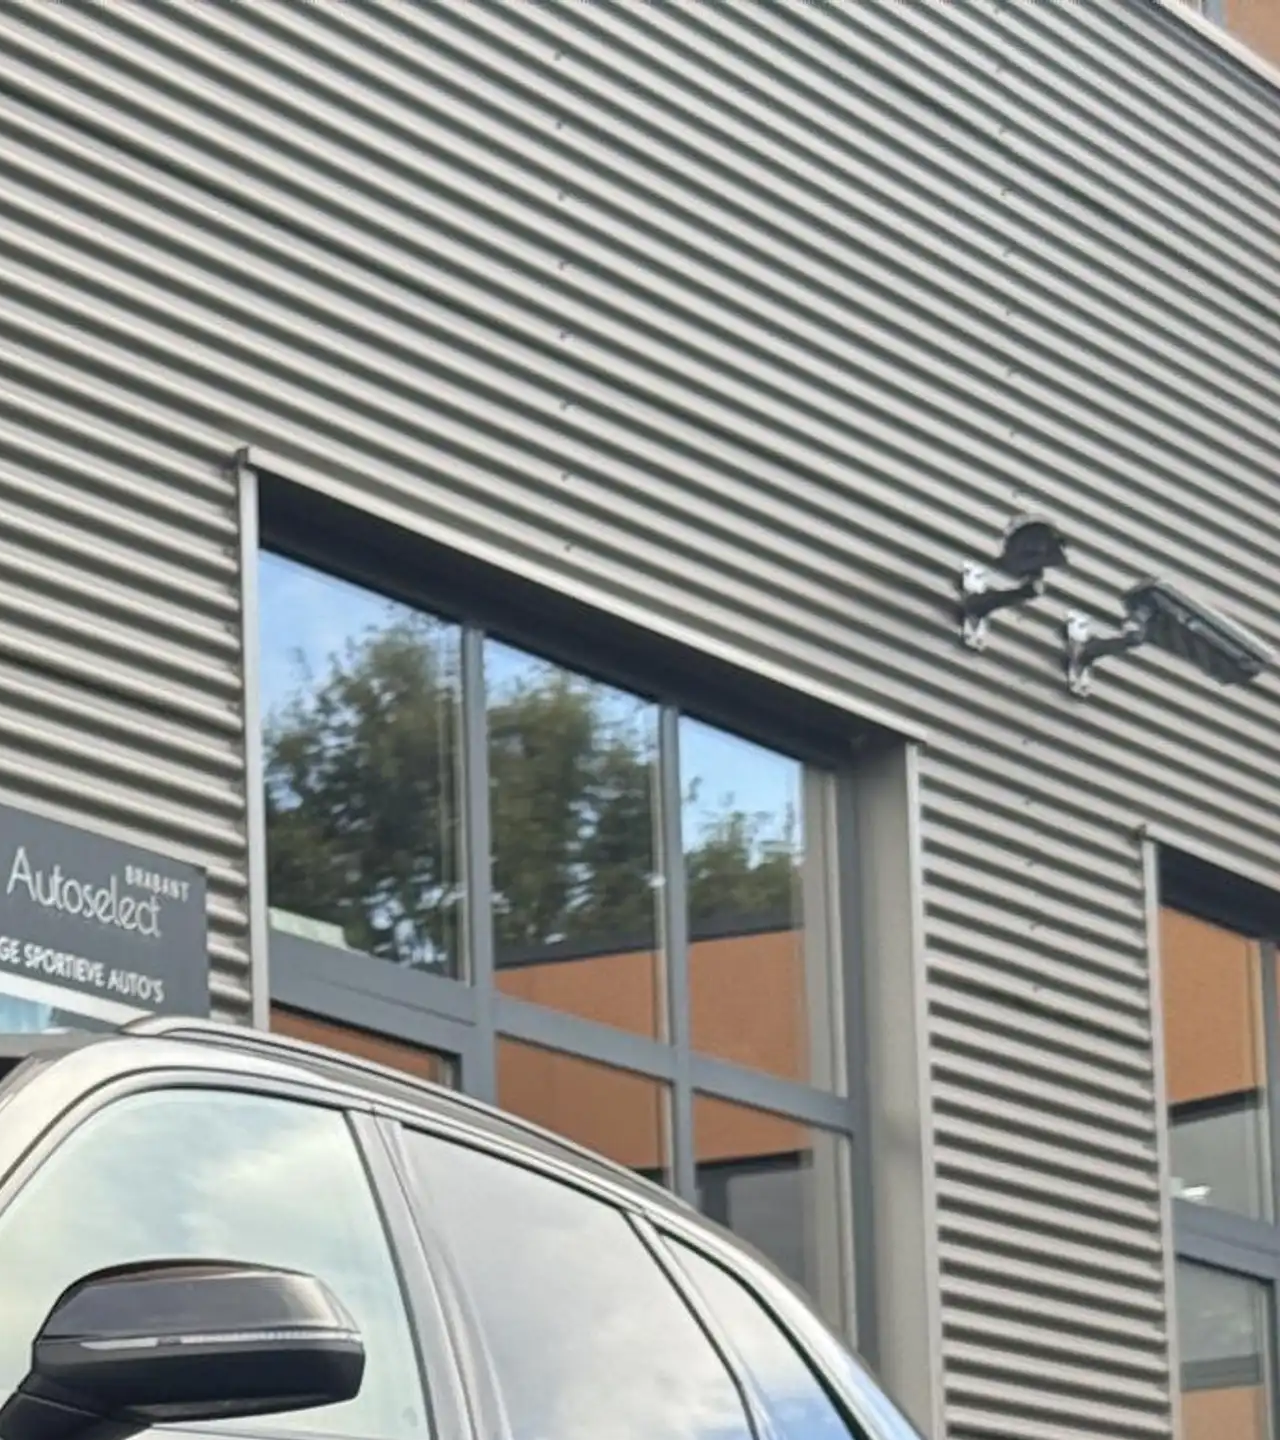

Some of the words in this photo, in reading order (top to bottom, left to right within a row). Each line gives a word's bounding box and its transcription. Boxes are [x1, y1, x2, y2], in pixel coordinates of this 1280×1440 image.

[7, 846, 162, 938] Autoselect
[125, 864, 190, 903] BRABANT
[24, 942, 105, 988] SPORTIEVE
[108, 965, 165, 1003] AUTO'S
